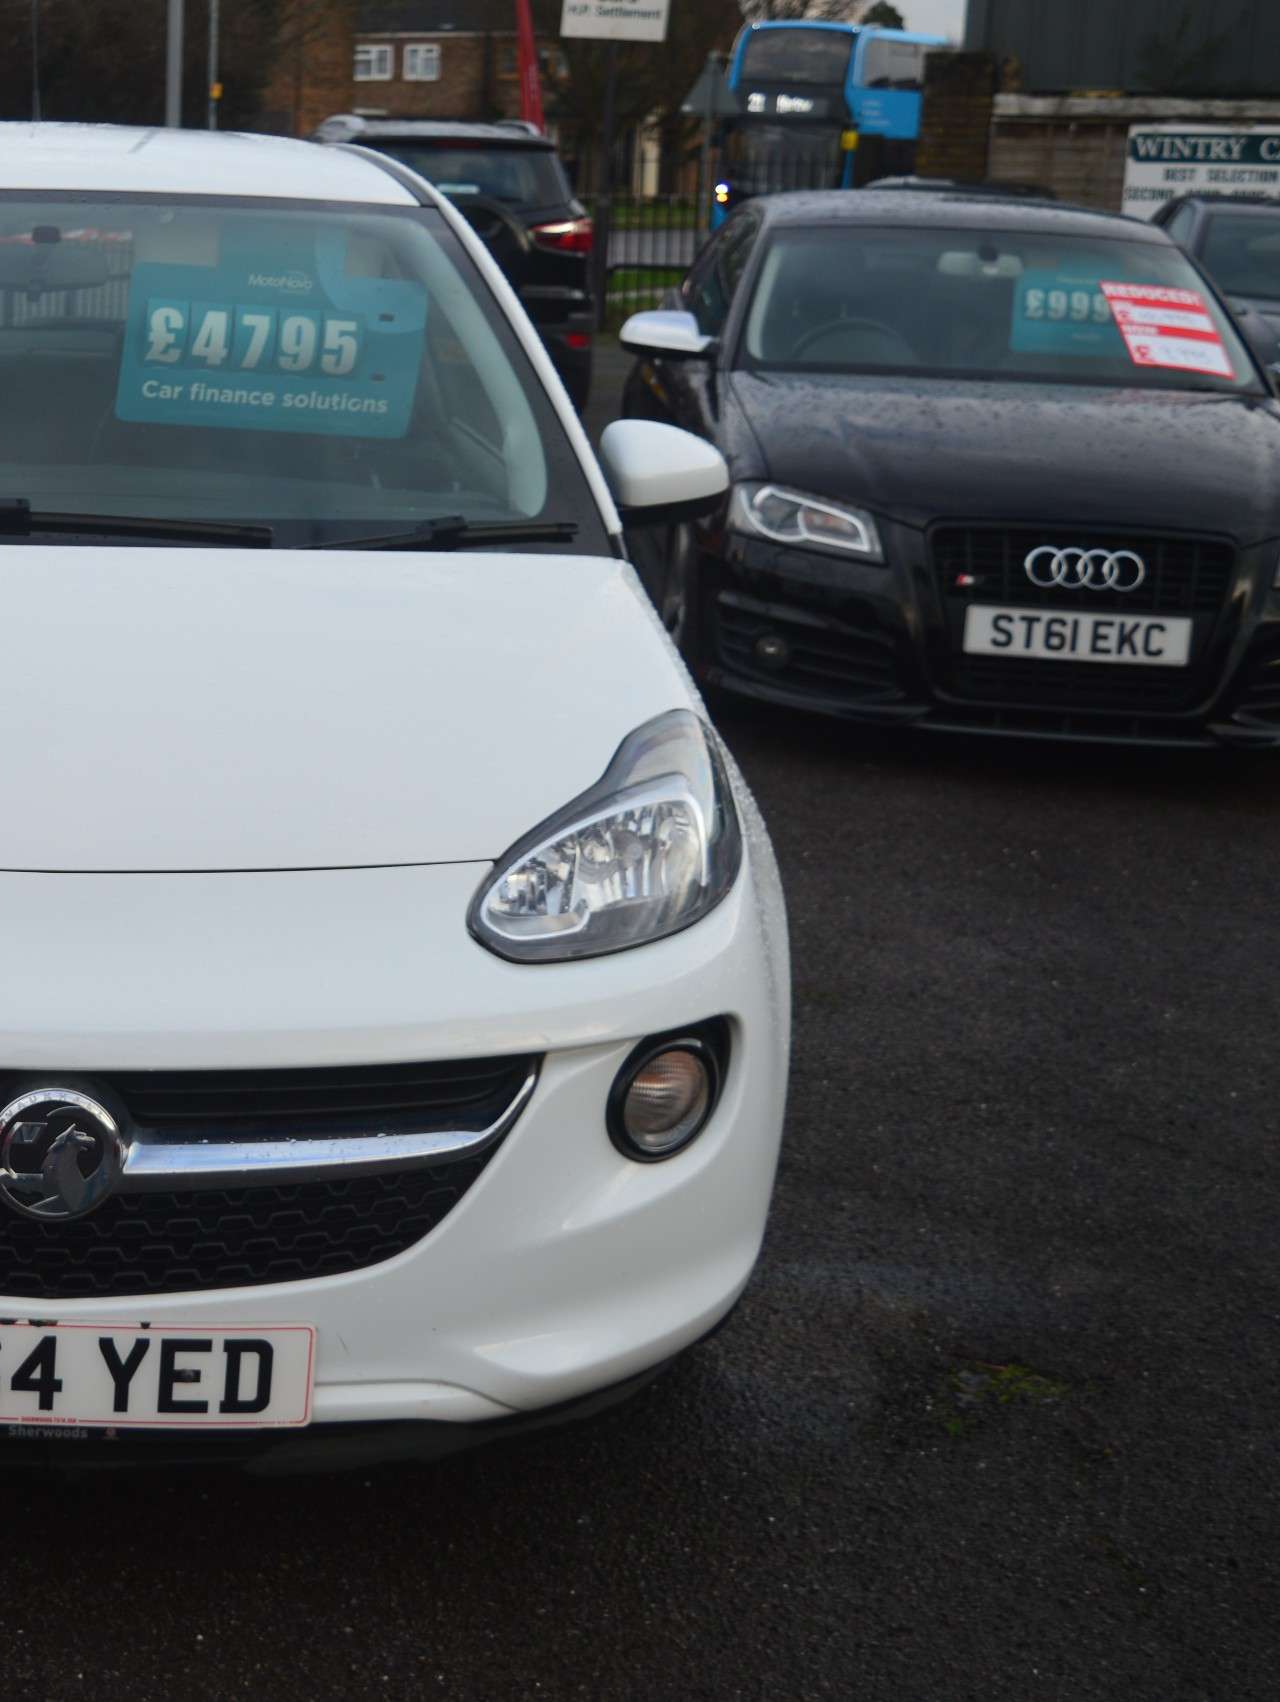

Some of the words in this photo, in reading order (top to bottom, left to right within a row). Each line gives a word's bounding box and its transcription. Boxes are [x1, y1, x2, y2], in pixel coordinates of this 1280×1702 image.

[596, 6, 661, 19] Settlement
[1136, 136, 1246, 161] WINTRY
[1260, 138, 1280, 161] C
[1164, 168, 1196, 182] BEST
[145, 307, 358, 376] £4795
[142, 380, 182, 399] Car
[190, 383, 274, 405] finance
[283, 391, 388, 413] solutions
[990, 613, 1079, 652] ST61
[1090, 620, 1166, 657] EKC
[98, 1336, 274, 1414] YED
[8, 1424, 88, 1439] Sherwoods
